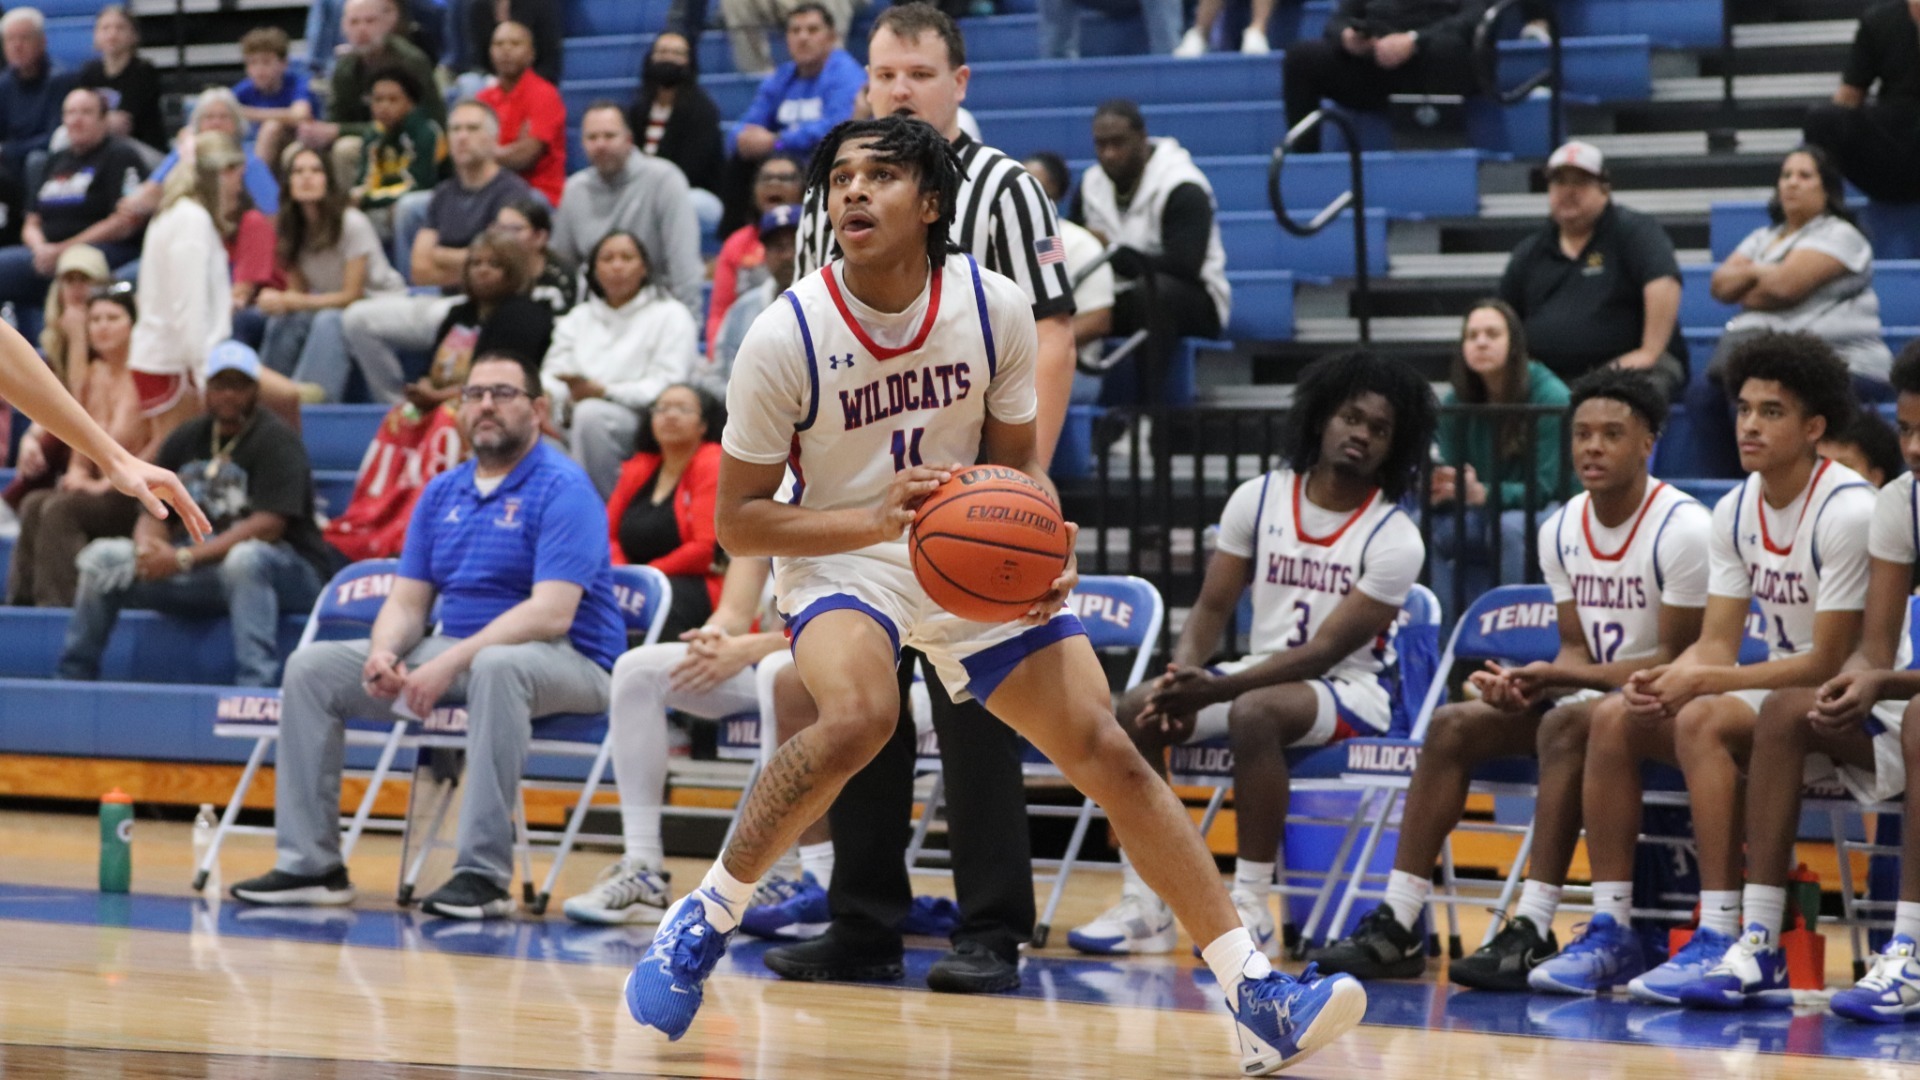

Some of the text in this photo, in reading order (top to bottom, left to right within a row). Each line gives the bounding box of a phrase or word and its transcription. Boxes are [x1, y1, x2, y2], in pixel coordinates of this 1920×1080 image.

[839, 362, 972, 431] WILDCATS
[966, 505, 1058, 534] EVOLUTION
[336, 573, 396, 606] TEM
[1266, 552, 1352, 596] WILDCATS
[1286, 600, 1310, 648] 3
[1479, 602, 1558, 637] TEMP
[1593, 621, 1624, 664] 12
[1347, 744, 1423, 771] WILDCA
